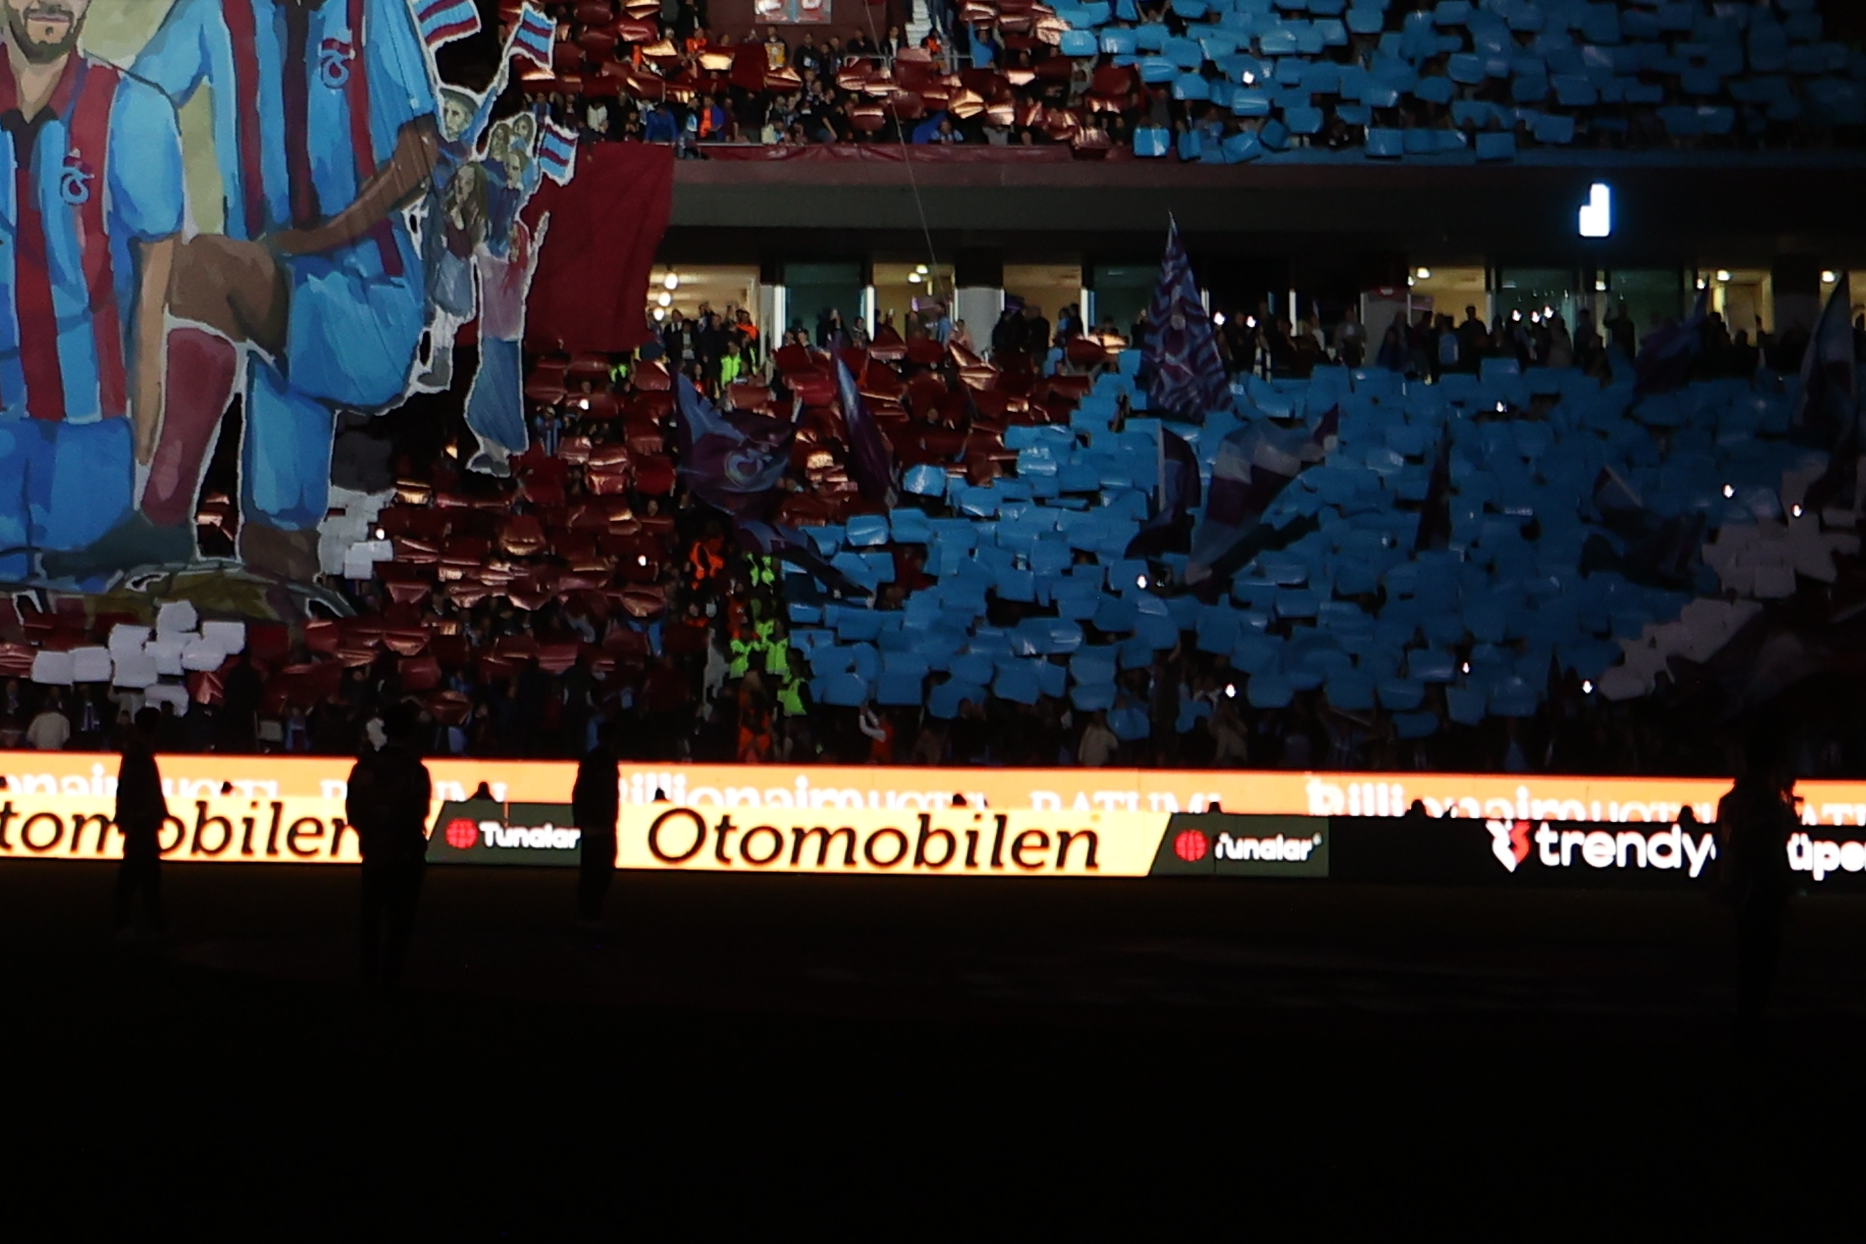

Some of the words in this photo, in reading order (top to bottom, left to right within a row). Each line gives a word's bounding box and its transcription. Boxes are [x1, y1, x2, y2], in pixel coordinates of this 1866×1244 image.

[478, 821, 581, 849] Tunalar
[648, 807, 1100, 870] Otomobilen
[1535, 822, 1716, 878] trendy
